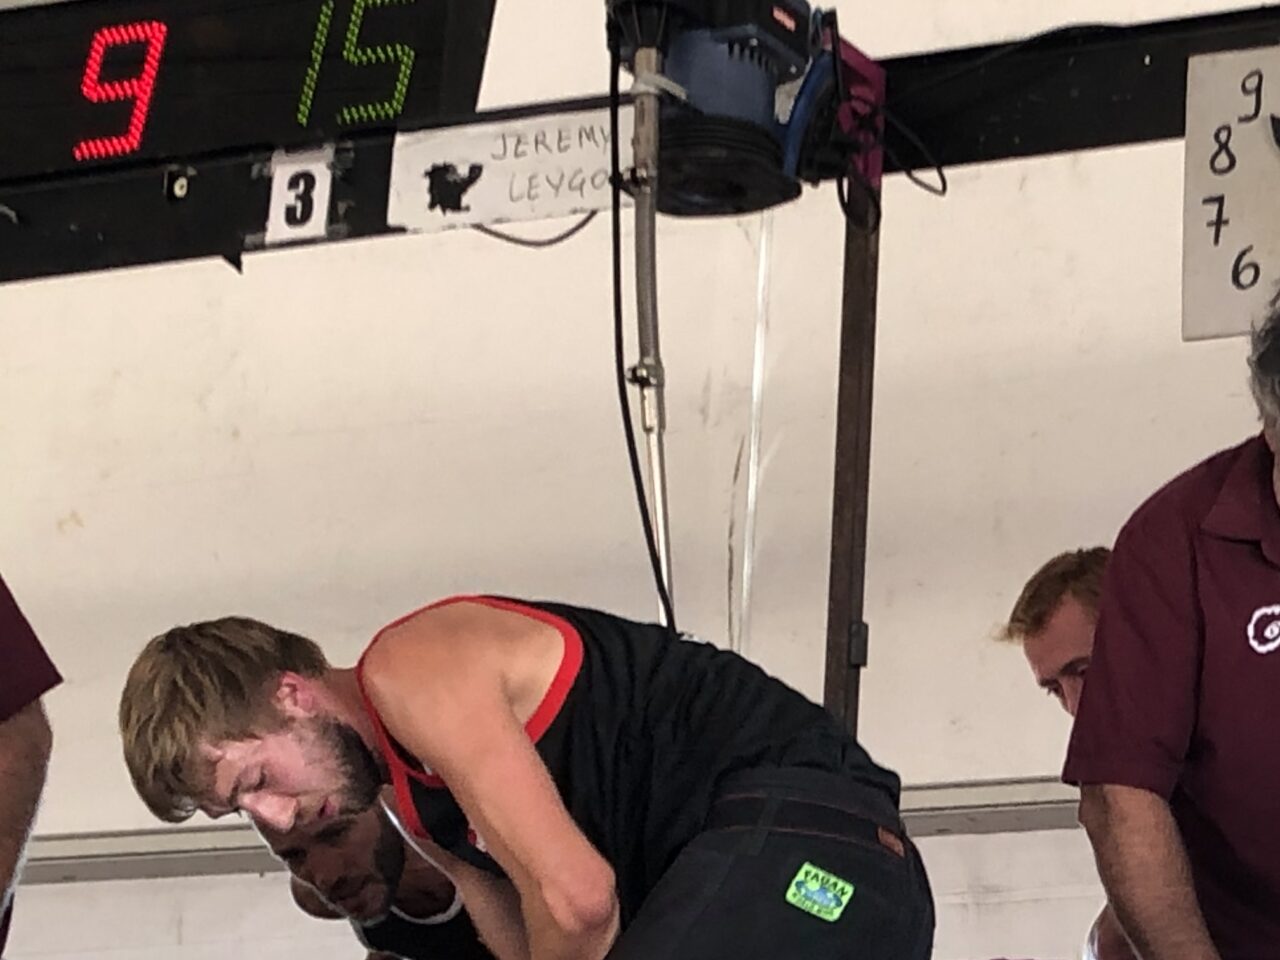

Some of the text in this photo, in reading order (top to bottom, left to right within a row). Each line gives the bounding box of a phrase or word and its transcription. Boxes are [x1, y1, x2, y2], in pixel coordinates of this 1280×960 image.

[296, 0, 415, 126] 15
[73, 21, 166, 161] 9
[1237, 68, 1264, 124] 9
[1209, 124, 1237, 175] 8
[284, 171, 316, 226] 3
[1202, 194, 1230, 246] 7
[1231, 245, 1261, 290] 6
